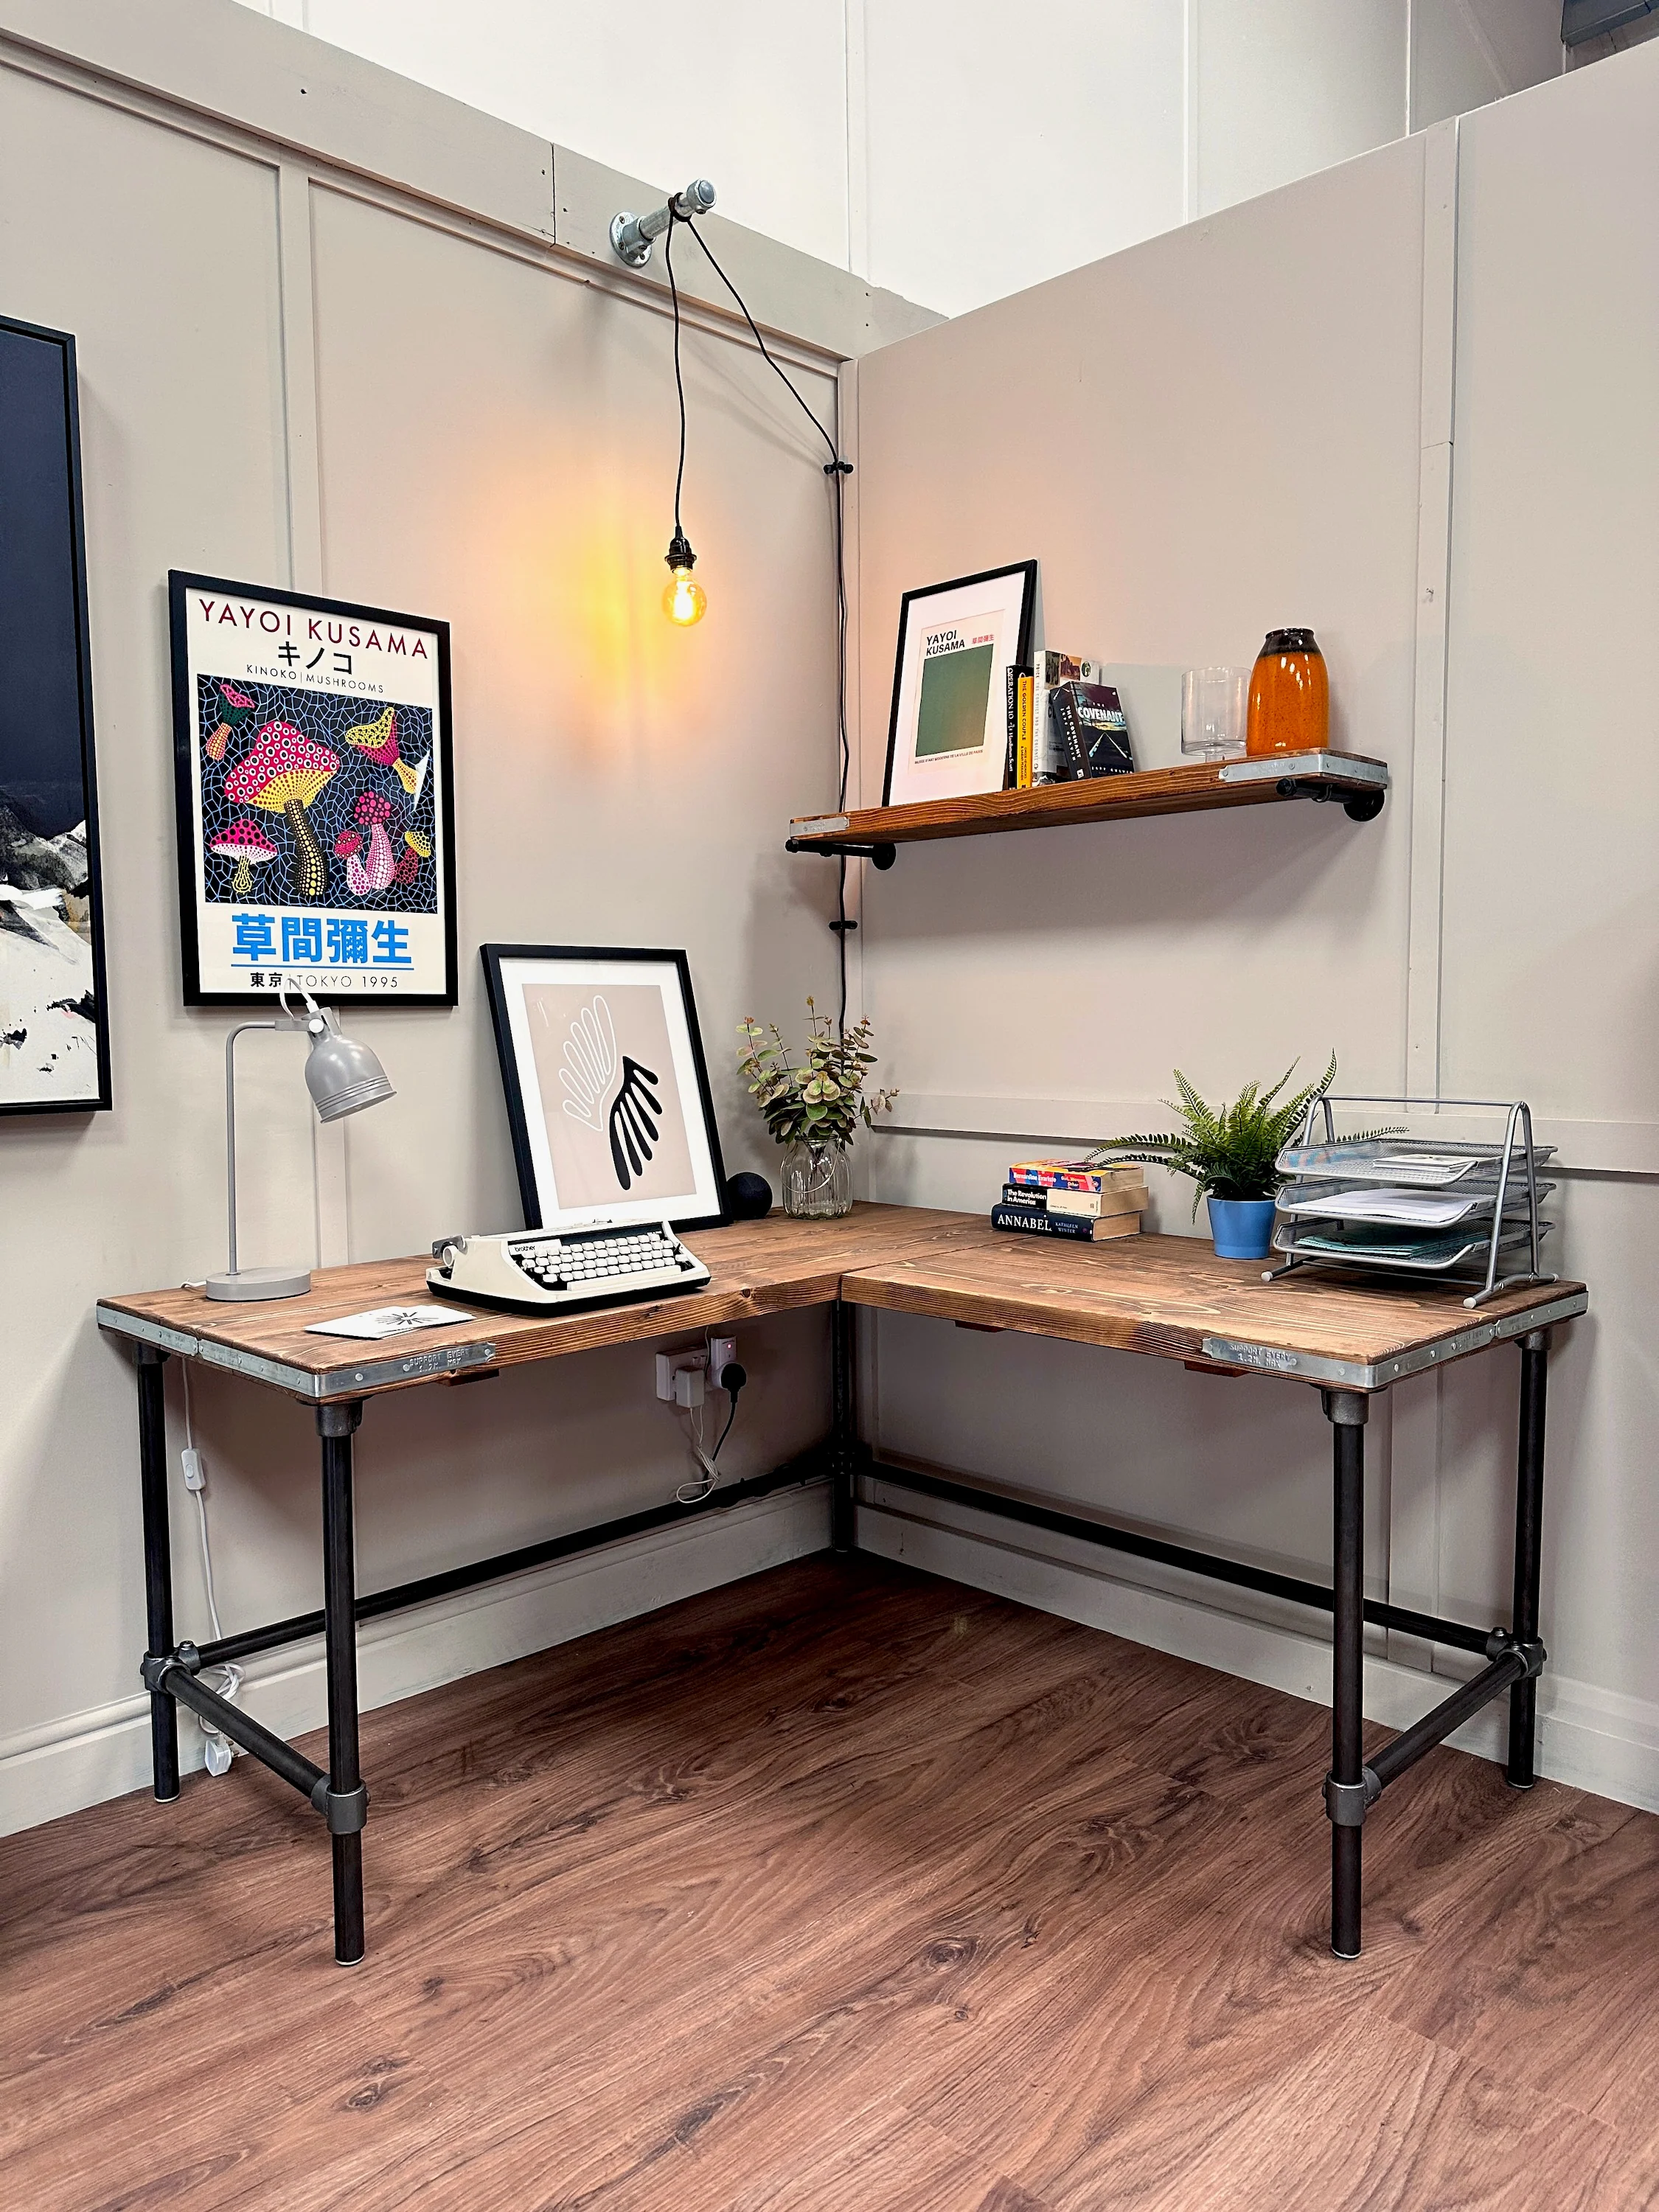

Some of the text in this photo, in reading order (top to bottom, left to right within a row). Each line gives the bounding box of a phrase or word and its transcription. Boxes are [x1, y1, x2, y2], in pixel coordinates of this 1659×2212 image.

[198, 598, 428, 659] YAYOI KUSAMA
[926, 630, 957, 646] YAYOI
[926, 639, 965, 656] KUSAMA
[278, 641, 352, 675] キノコ
[246, 664, 384, 694] KINOKO MUSHROOMS
[1077, 706, 1123, 723] COVENANT
[1069, 721, 1082, 758] COVENANT
[232, 913, 412, 964] 草間彌生
[250, 972, 398, 988] 東京 TOKYO 1995
[1007, 1189, 1018, 1197] The
[1018, 1189, 1047, 1200] Revolution
[1012, 1196, 1036, 1206] America
[998, 1214, 1053, 1232] ANNABEL
[1055, 1221, 1079, 1229] KATHLEEN
